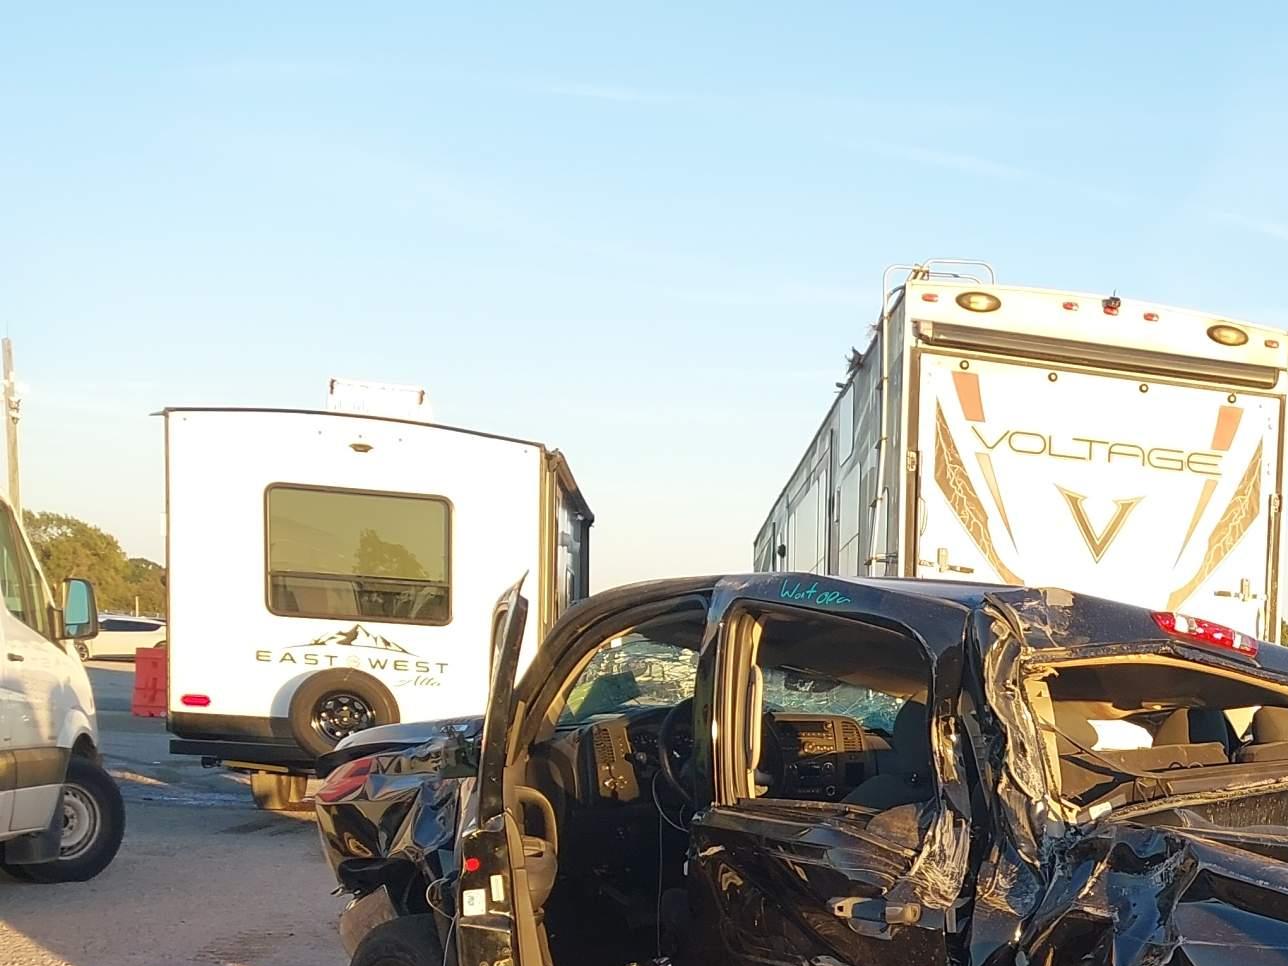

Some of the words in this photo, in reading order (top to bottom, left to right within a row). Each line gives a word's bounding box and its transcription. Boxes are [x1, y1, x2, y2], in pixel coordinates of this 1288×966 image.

[971, 425, 1223, 476] VOLTAGE
[255, 650, 338, 666] EAST
[368, 658, 449, 674] WEST
